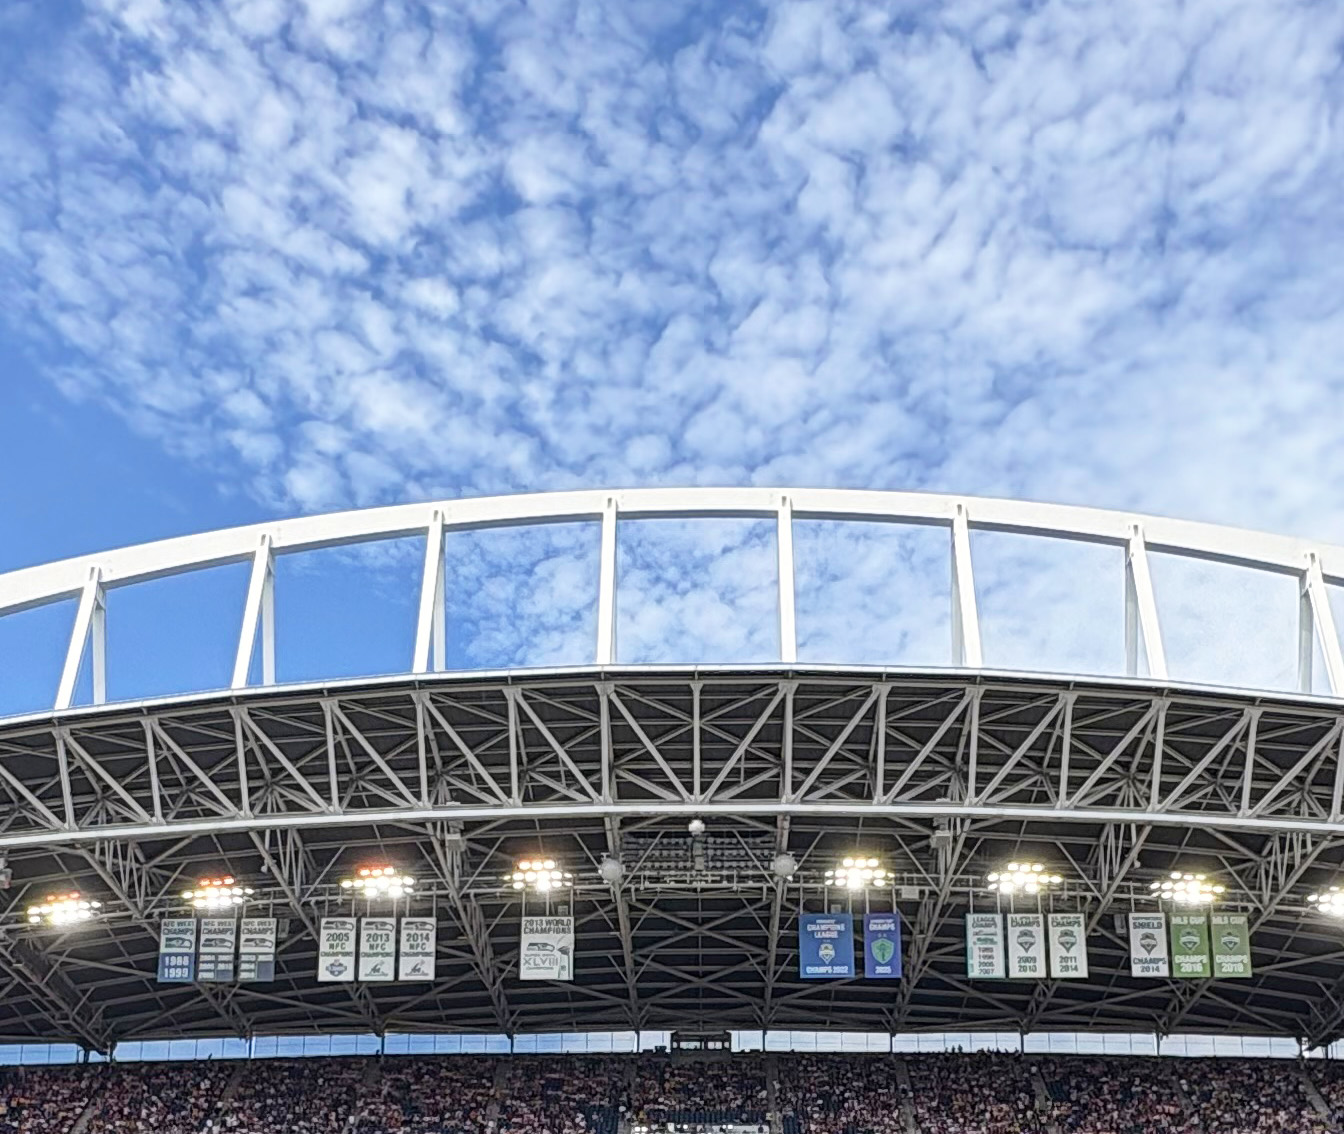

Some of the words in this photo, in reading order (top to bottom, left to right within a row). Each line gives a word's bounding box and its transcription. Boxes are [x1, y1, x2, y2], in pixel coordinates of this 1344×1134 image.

[326, 932, 349, 942] 2005
[366, 932, 390, 942] 2013
[406, 932, 430, 942] 2014
[329, 942, 346, 950] NFC
[369, 942, 386, 951] NFC
[409, 942, 426, 950] NFC
